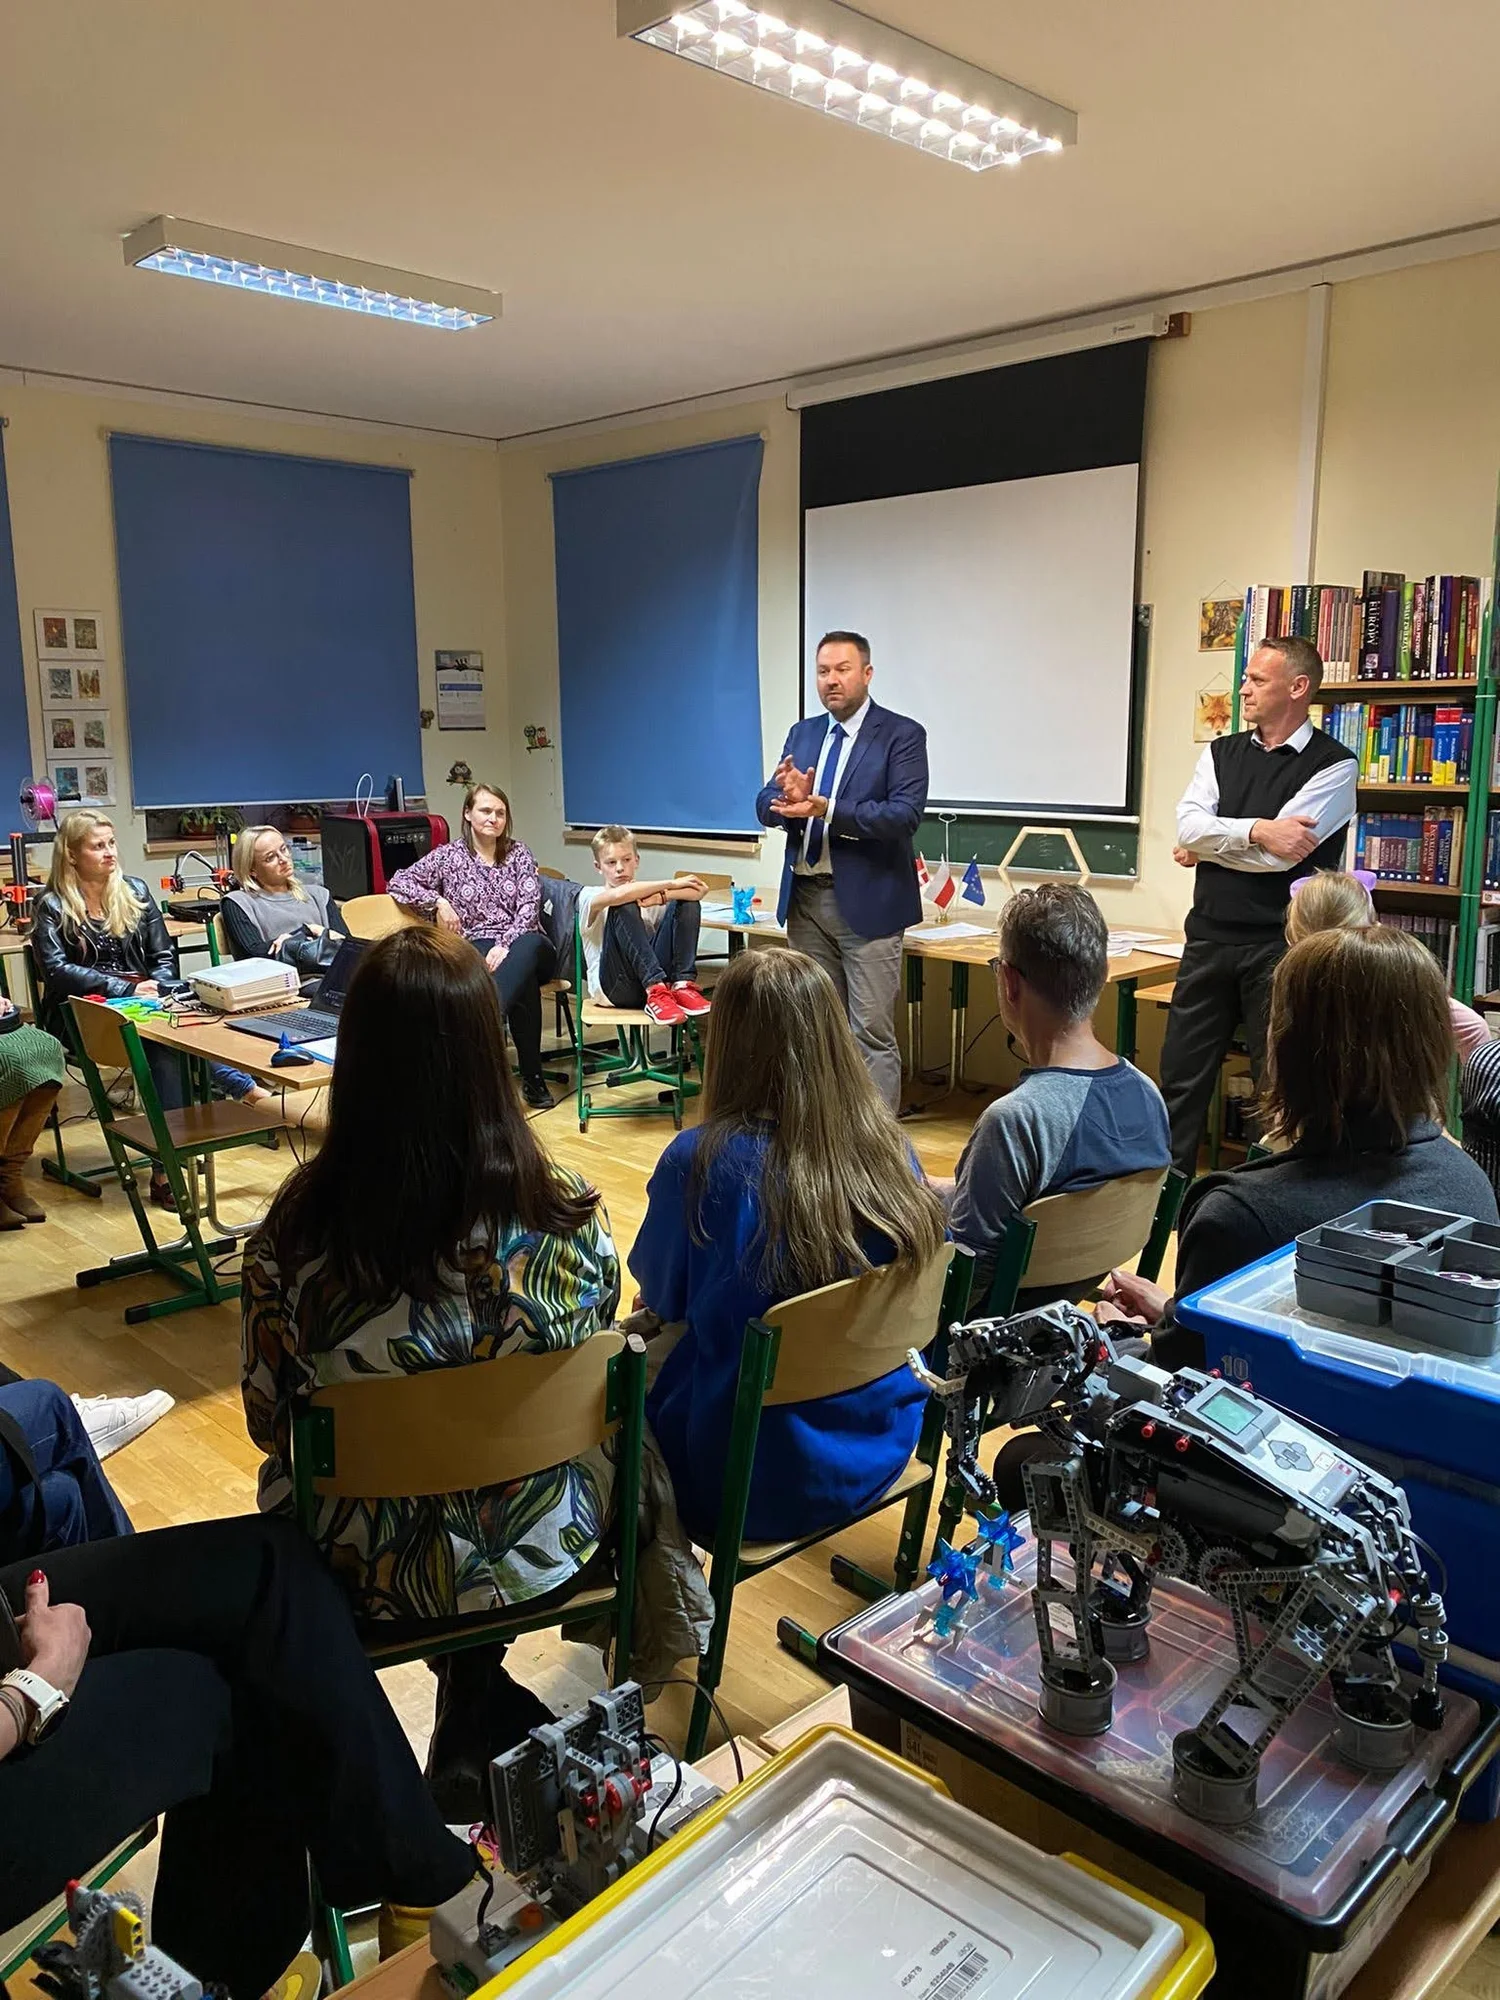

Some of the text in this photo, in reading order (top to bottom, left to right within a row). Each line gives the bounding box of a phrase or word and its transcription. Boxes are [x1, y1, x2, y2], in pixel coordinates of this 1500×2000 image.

[1367, 599, 1380, 646] EUROPY
[1426, 824, 1438, 872] ENCYKLOPEDIA
[1442, 829, 1452, 874] ENCYKLOPEDIA
[1221, 1354, 1249, 1381] 10
[900, 1965, 923, 1988] 45678
